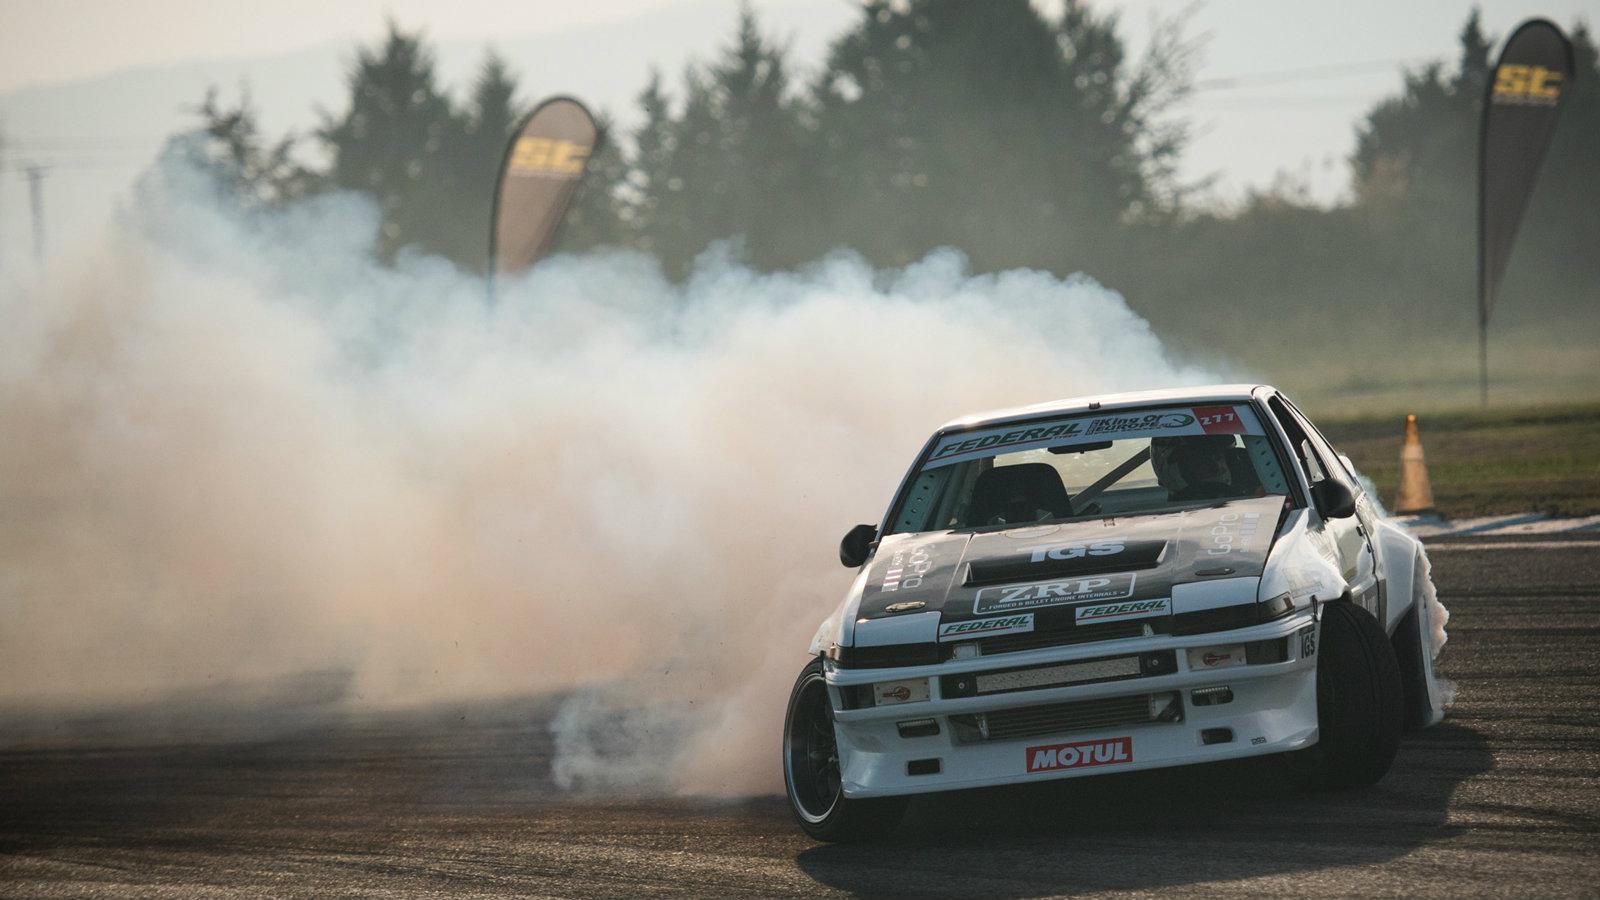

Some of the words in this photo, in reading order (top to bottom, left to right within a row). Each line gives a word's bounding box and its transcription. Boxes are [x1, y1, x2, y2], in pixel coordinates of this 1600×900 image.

[1095, 421, 1159, 432] EUROPE
[1098, 416, 1140, 427] King
[1201, 412, 1235, 425] 277
[935, 422, 1083, 457] FEDERAL
[1208, 512, 1239, 555] GoPro
[1017, 536, 1127, 562] TGS
[989, 600, 1018, 611] FORGED
[1024, 598, 1049, 608] BILLET
[1050, 594, 1077, 604] ENGINE
[1077, 590, 1118, 601] INTERNALS
[999, 578, 1111, 603] ZRP
[1080, 600, 1168, 618] FEDERAL
[944, 613, 1032, 634] FEDERAL
[1032, 742, 1128, 769] MOTUL
